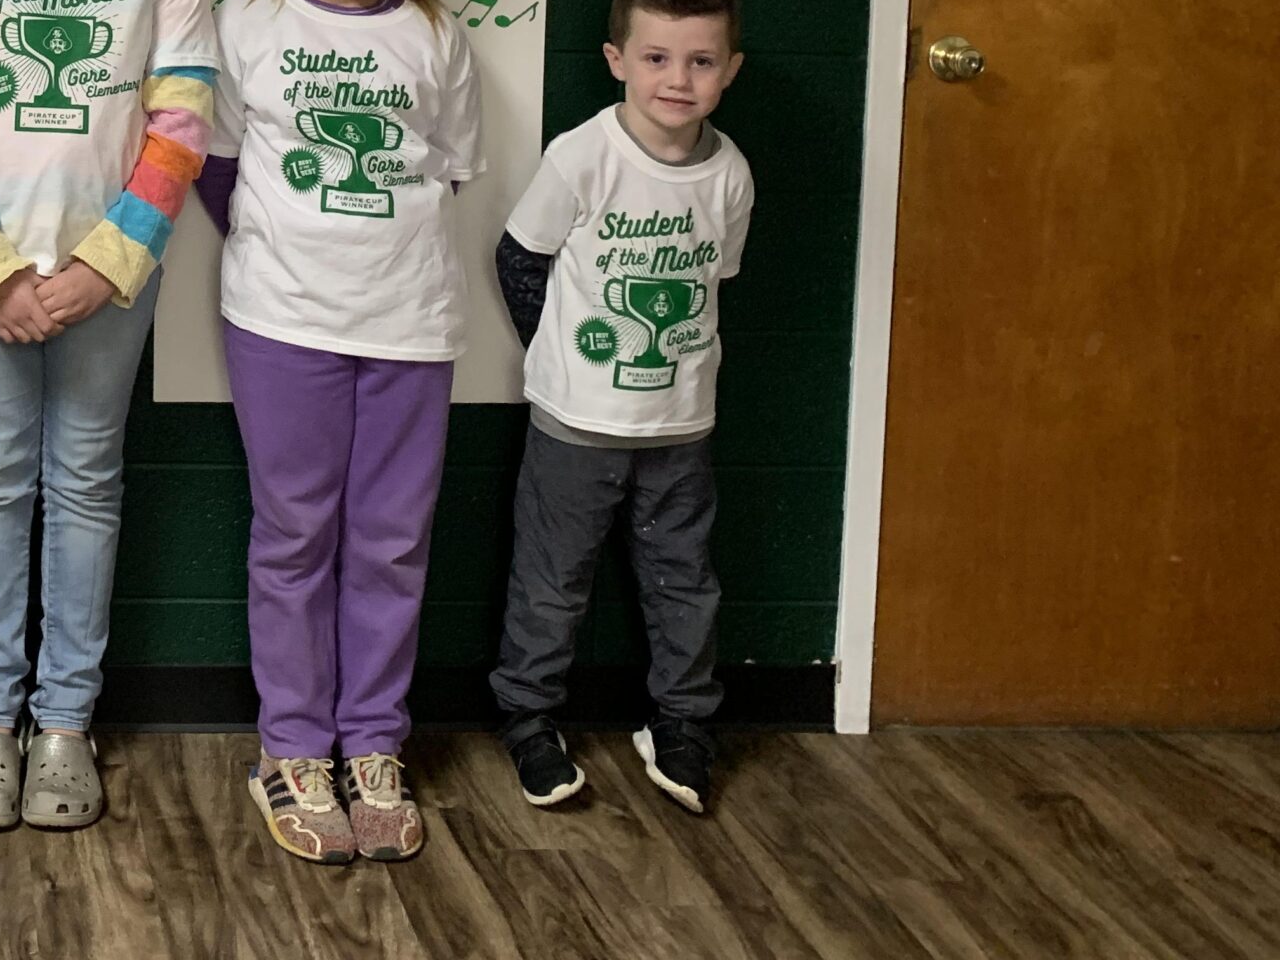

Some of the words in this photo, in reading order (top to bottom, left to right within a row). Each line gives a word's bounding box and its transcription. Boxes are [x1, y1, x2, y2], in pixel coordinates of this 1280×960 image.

[279, 47, 379, 75] Student
[68, 68, 111, 86] Gore
[283, 80, 302, 107] of
[304, 81, 332, 99] the
[333, 81, 414, 110] Month
[367, 155, 406, 174] Gore
[340, 201, 375, 209] WINNER
[598, 207, 693, 240] Student
[596, 248, 617, 274] of
[619, 248, 649, 266] the
[666, 328, 702, 346] Gore
